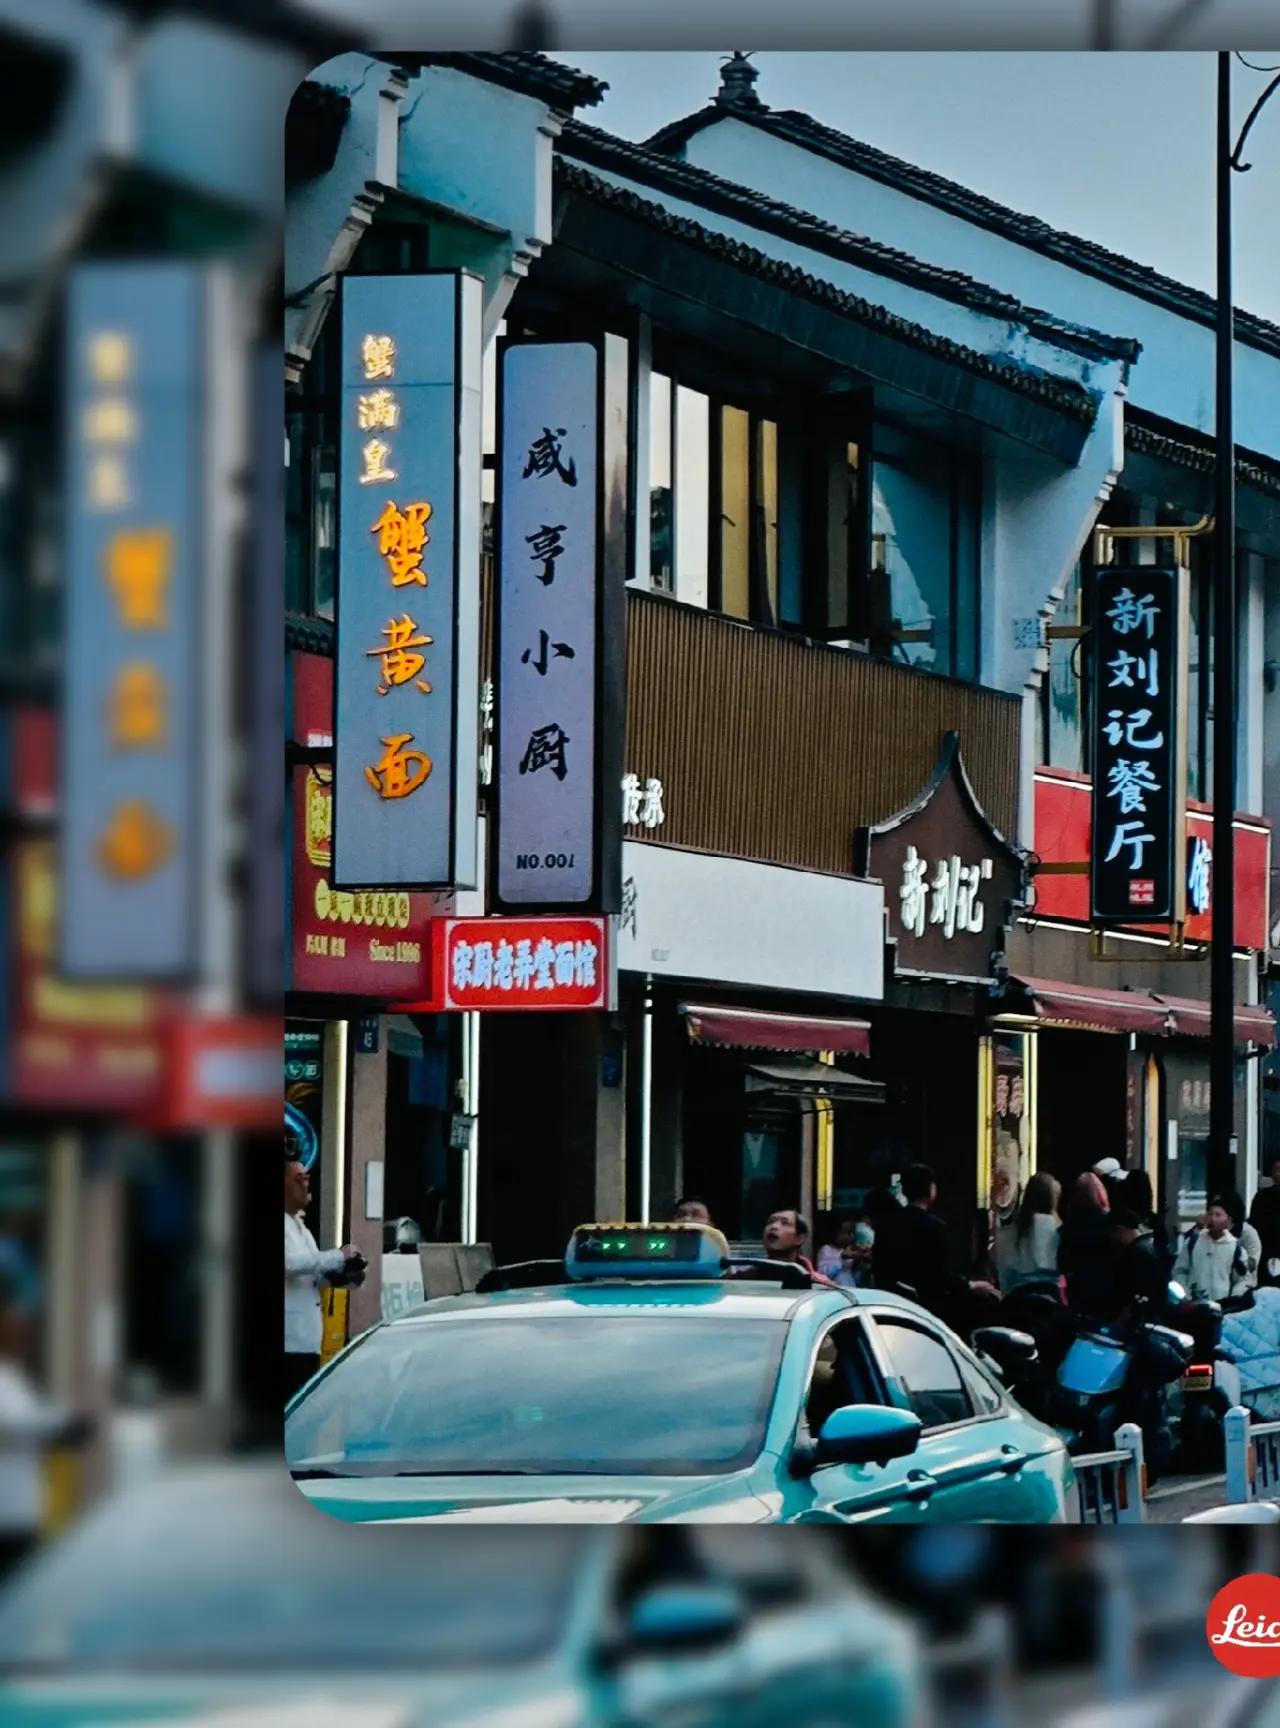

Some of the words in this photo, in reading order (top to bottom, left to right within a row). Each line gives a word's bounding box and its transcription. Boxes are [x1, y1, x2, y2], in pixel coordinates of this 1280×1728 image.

[363, 499, 434, 799] 蟹黄面
[519, 427, 578, 781] 咸亨小厨
[1102, 588, 1164, 870] 新刘记餐厅
